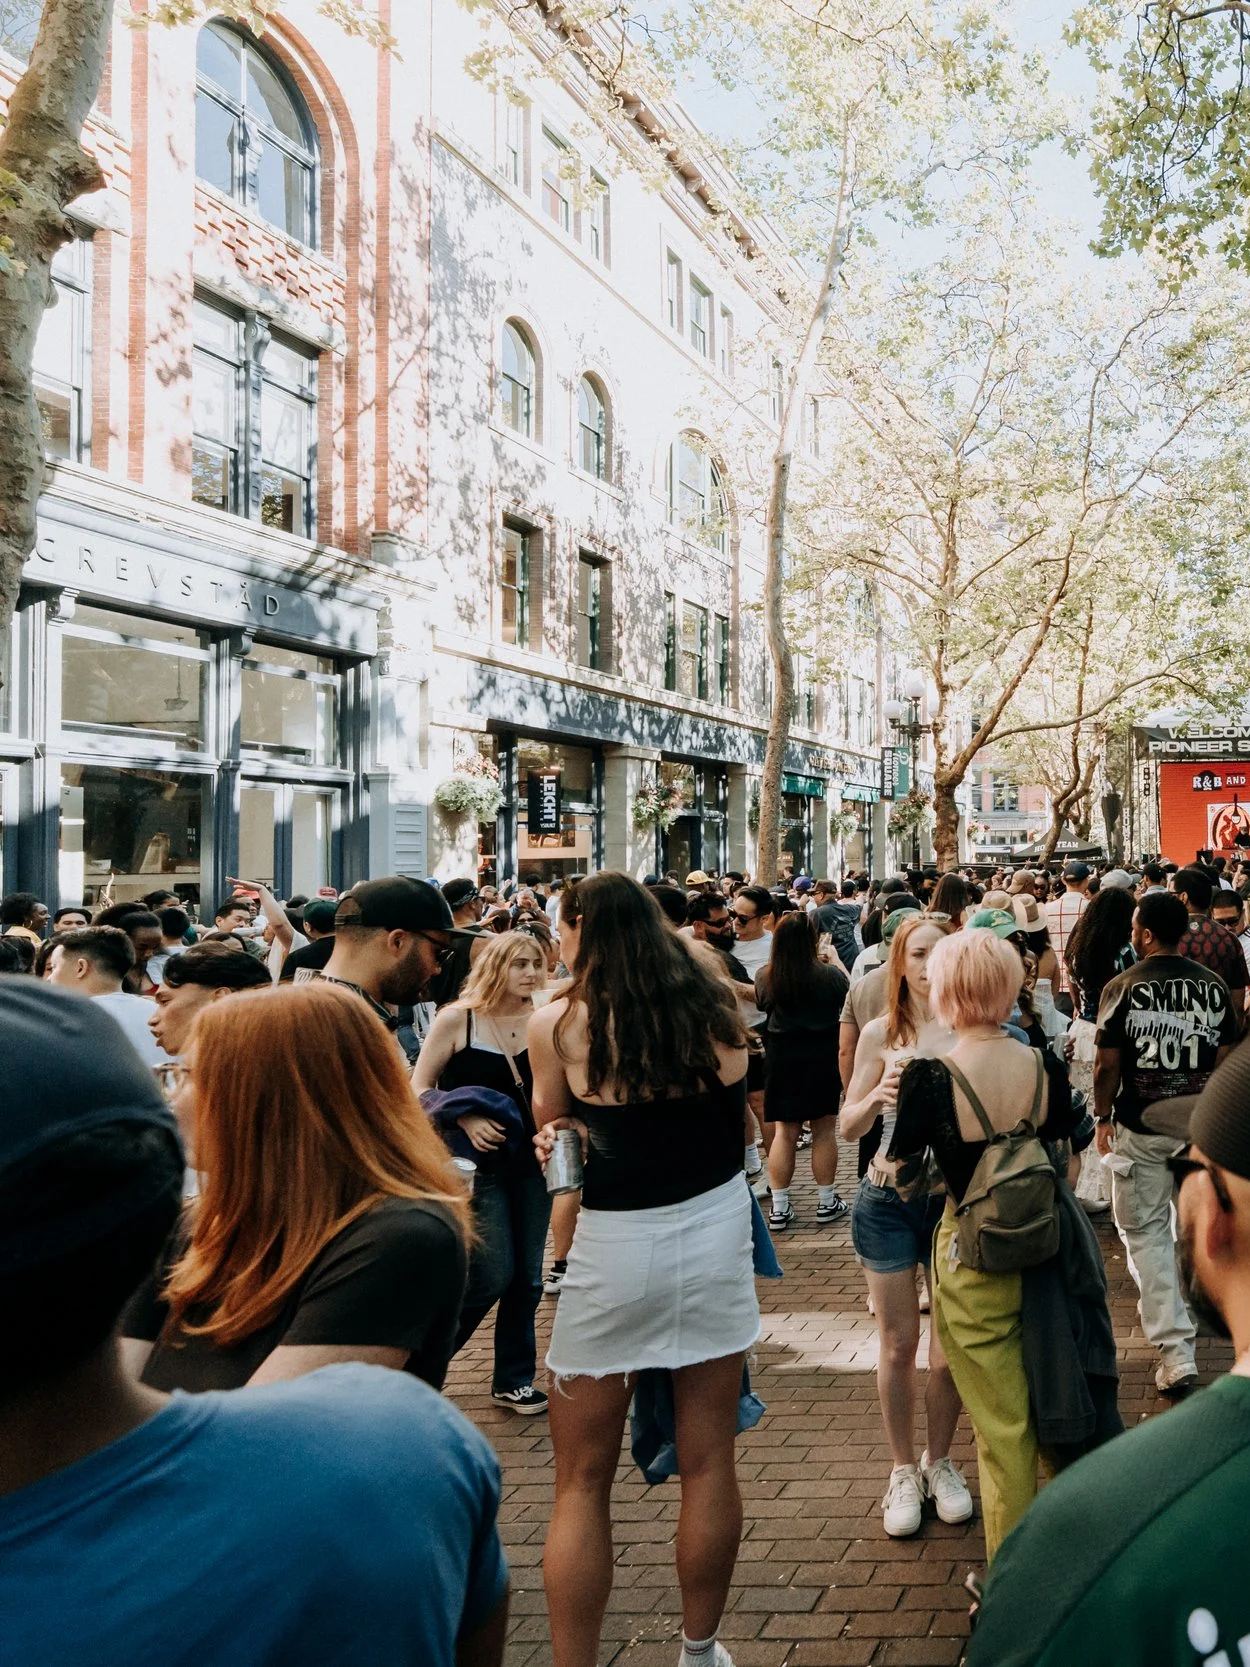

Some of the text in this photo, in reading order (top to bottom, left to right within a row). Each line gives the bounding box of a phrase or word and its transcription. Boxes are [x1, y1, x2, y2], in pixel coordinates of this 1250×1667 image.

[1149, 740, 1233, 753] PIONEER
[883, 750, 893, 796] SQUARE
[892, 750, 909, 786] Pioneer
[1193, 775, 1222, 789] R&B
[1226, 776, 1246, 785] AND
[543, 775, 556, 821] LEICHT
[1131, 979, 1227, 1027] SMINO
[1135, 1034, 1199, 1070] 201
